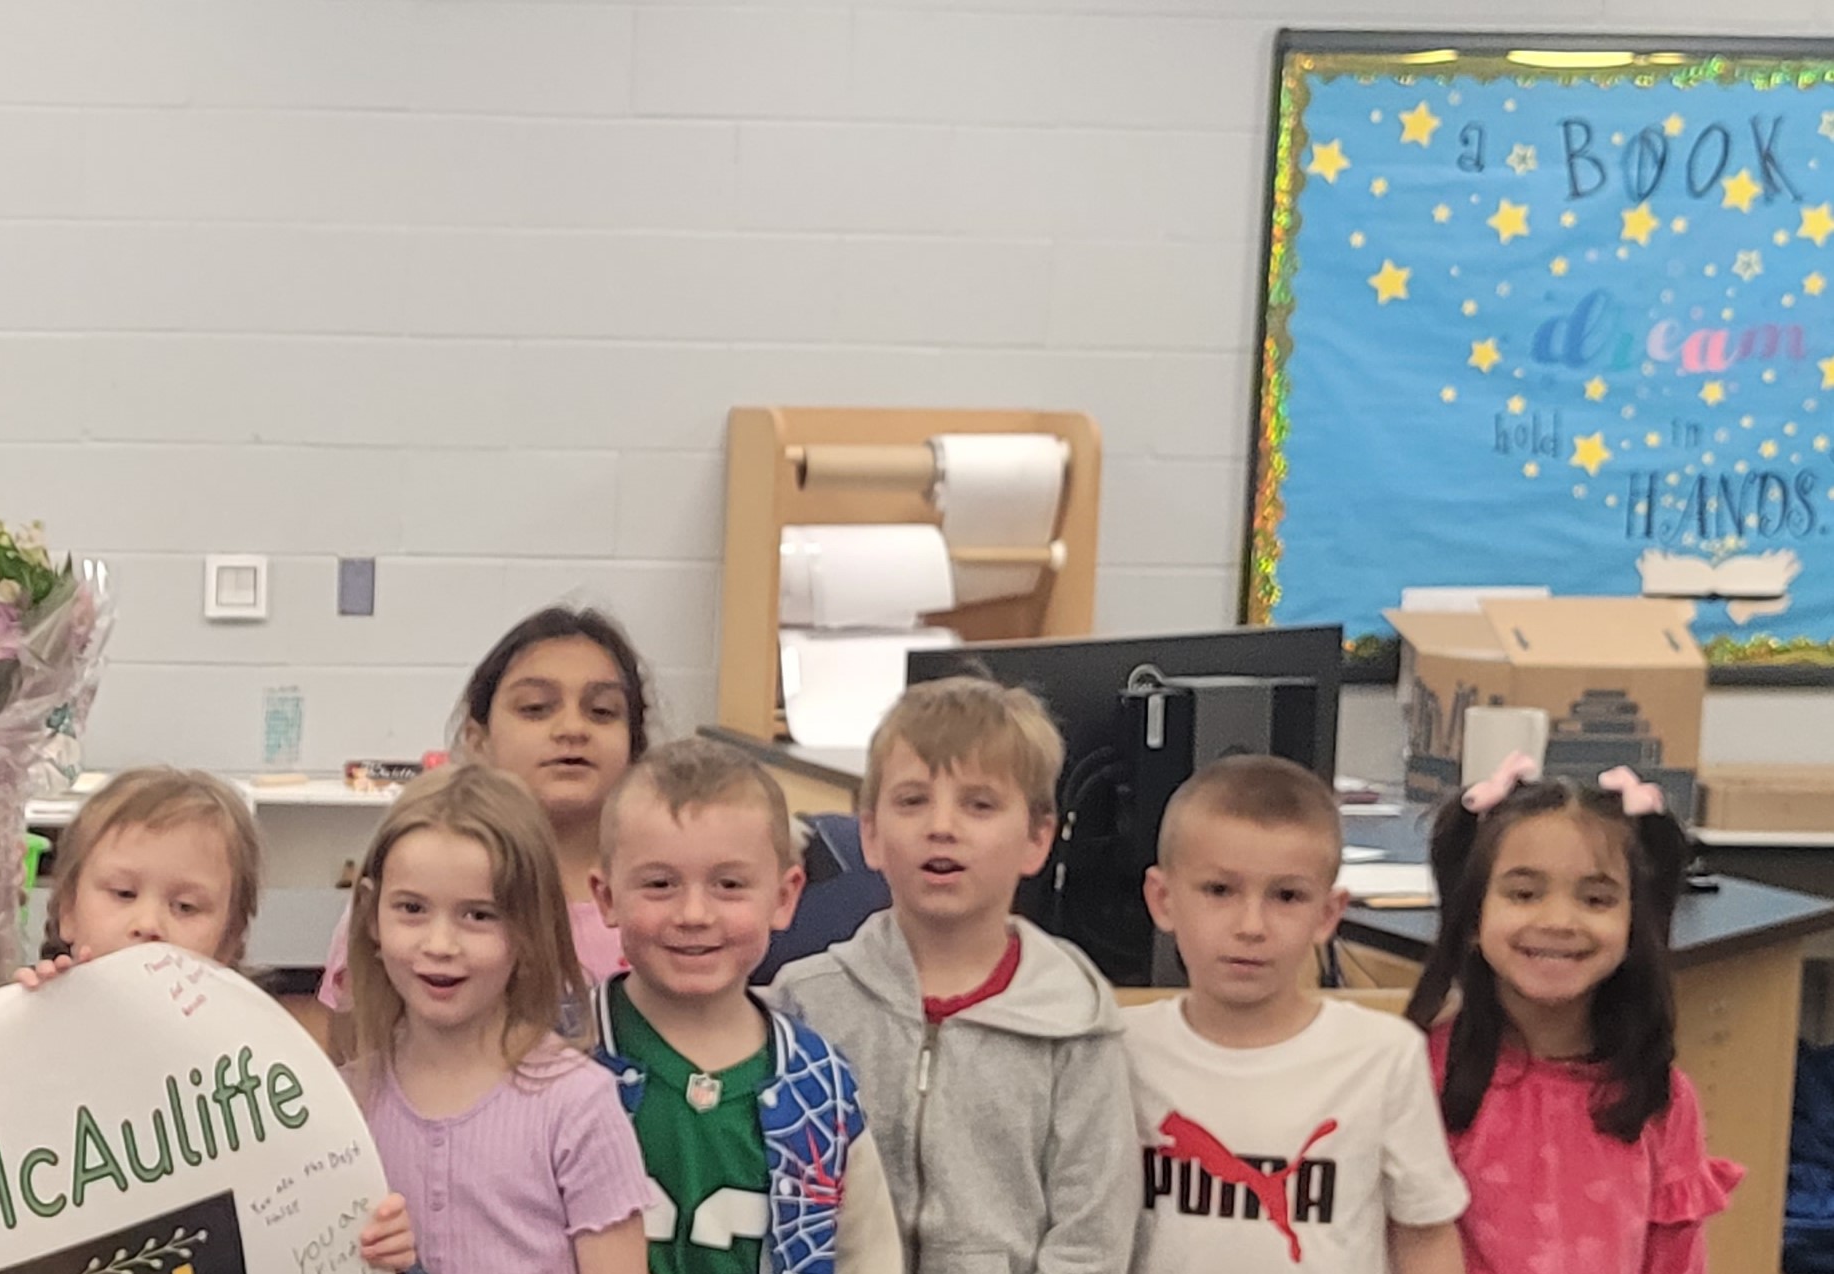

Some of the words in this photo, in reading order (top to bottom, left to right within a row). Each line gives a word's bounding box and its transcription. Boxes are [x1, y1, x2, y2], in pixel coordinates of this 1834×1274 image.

[1558, 114, 1804, 205] BOOK
[1529, 288, 1806, 371] dream
[1494, 410, 1563, 458] hold
[1670, 417, 1704, 450] in
